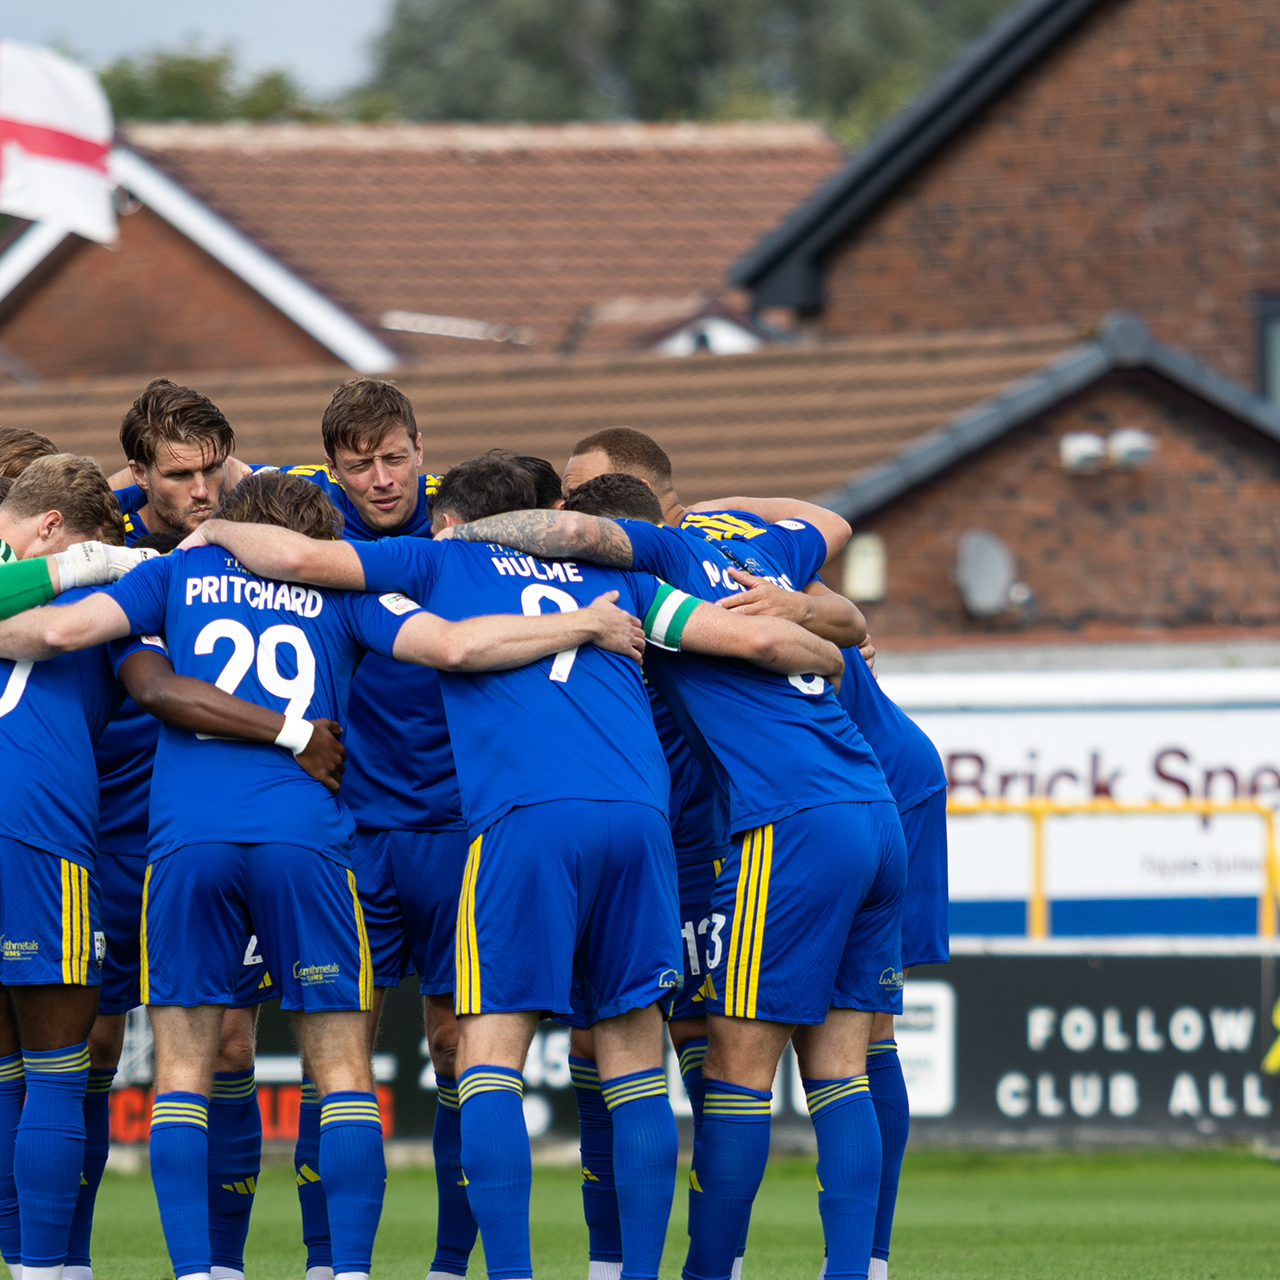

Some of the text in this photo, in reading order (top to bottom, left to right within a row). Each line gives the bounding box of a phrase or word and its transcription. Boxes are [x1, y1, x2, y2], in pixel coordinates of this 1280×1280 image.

[491, 556, 583, 582] HULME
[185, 575, 324, 618] PRITCHARD
[194, 618, 316, 741] 29
[946, 749, 1126, 806] Brick
[681, 912, 726, 976] 13
[1026, 1006, 1257, 1053] FOLLOW
[995, 1070, 1140, 1119] CLUB
[1167, 1070, 1272, 1119] ALL
